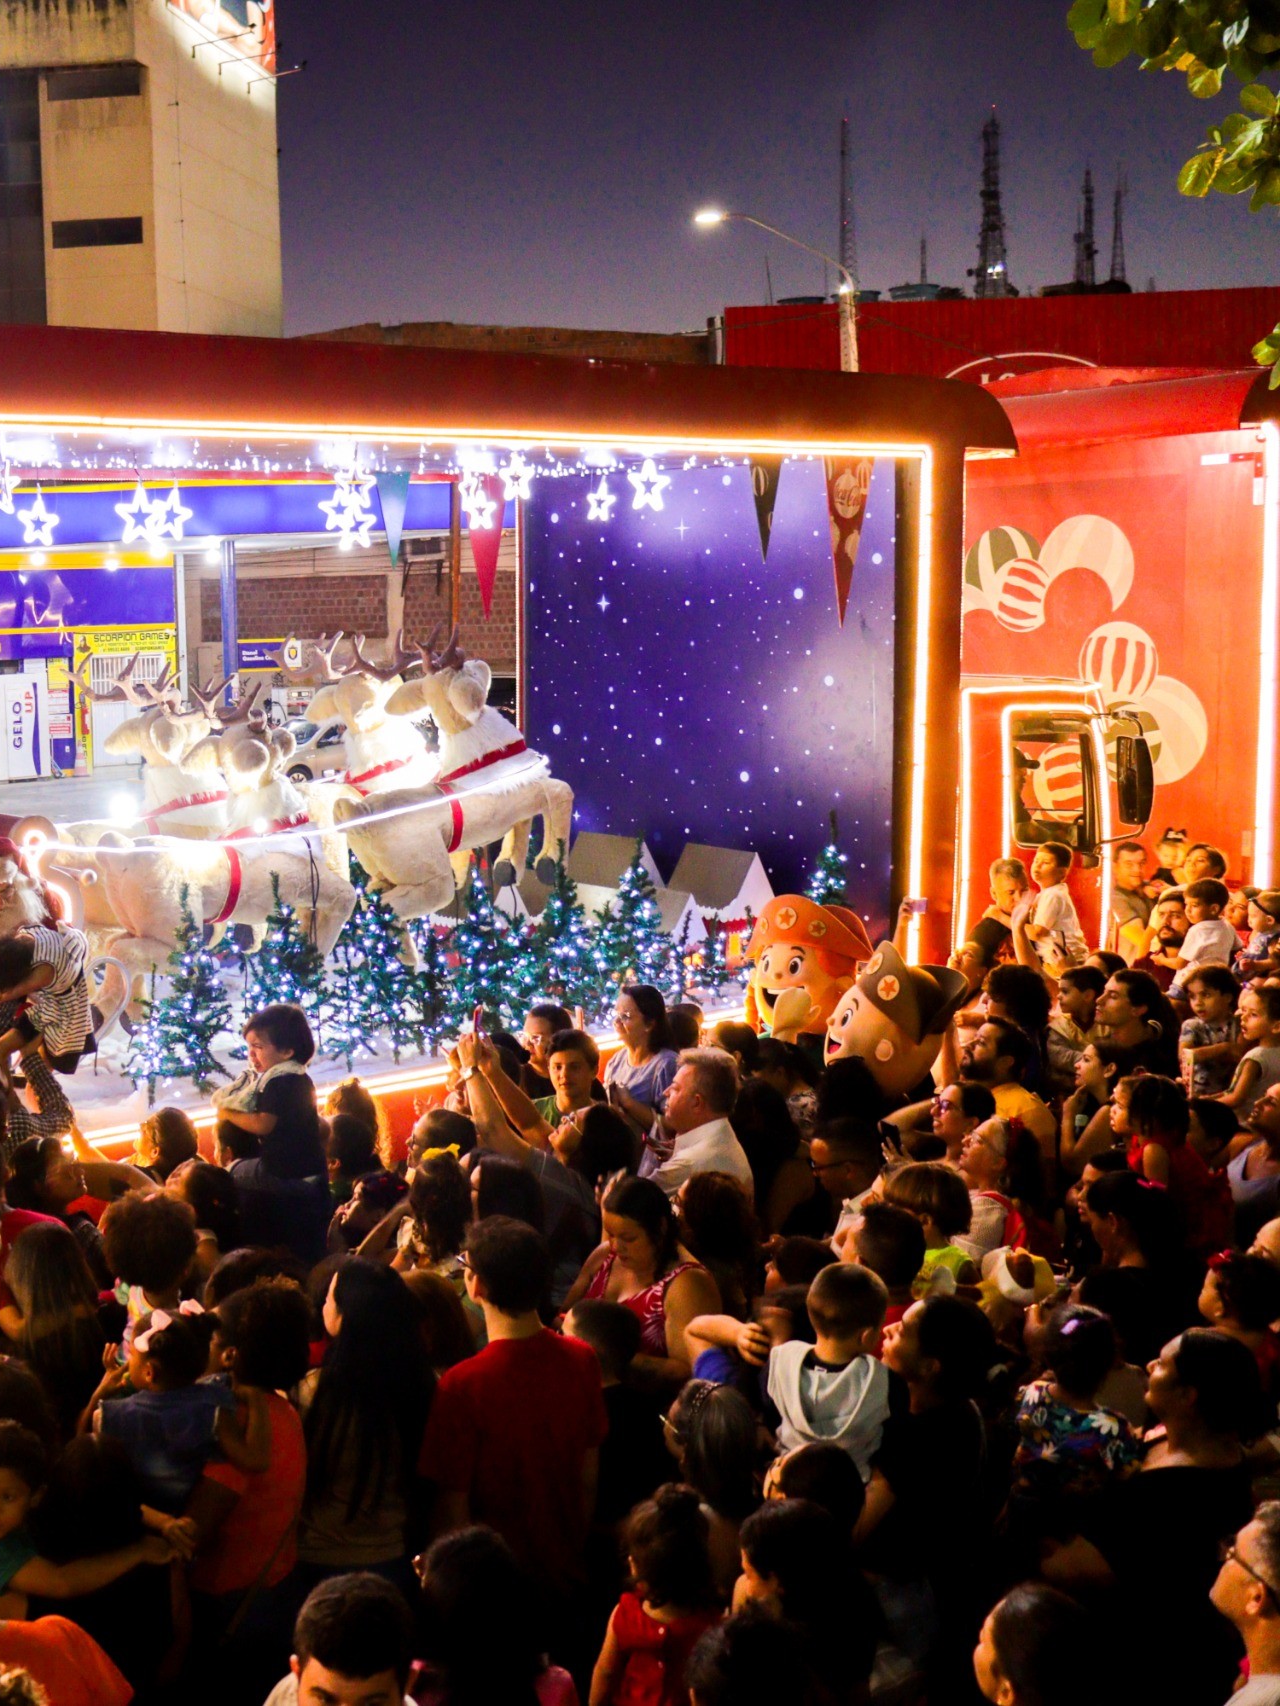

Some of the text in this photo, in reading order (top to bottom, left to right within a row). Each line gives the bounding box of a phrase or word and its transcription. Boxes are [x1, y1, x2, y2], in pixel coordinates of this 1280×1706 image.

[140, 632, 169, 641] GAMES
[12, 691, 33, 750] GELO UP
